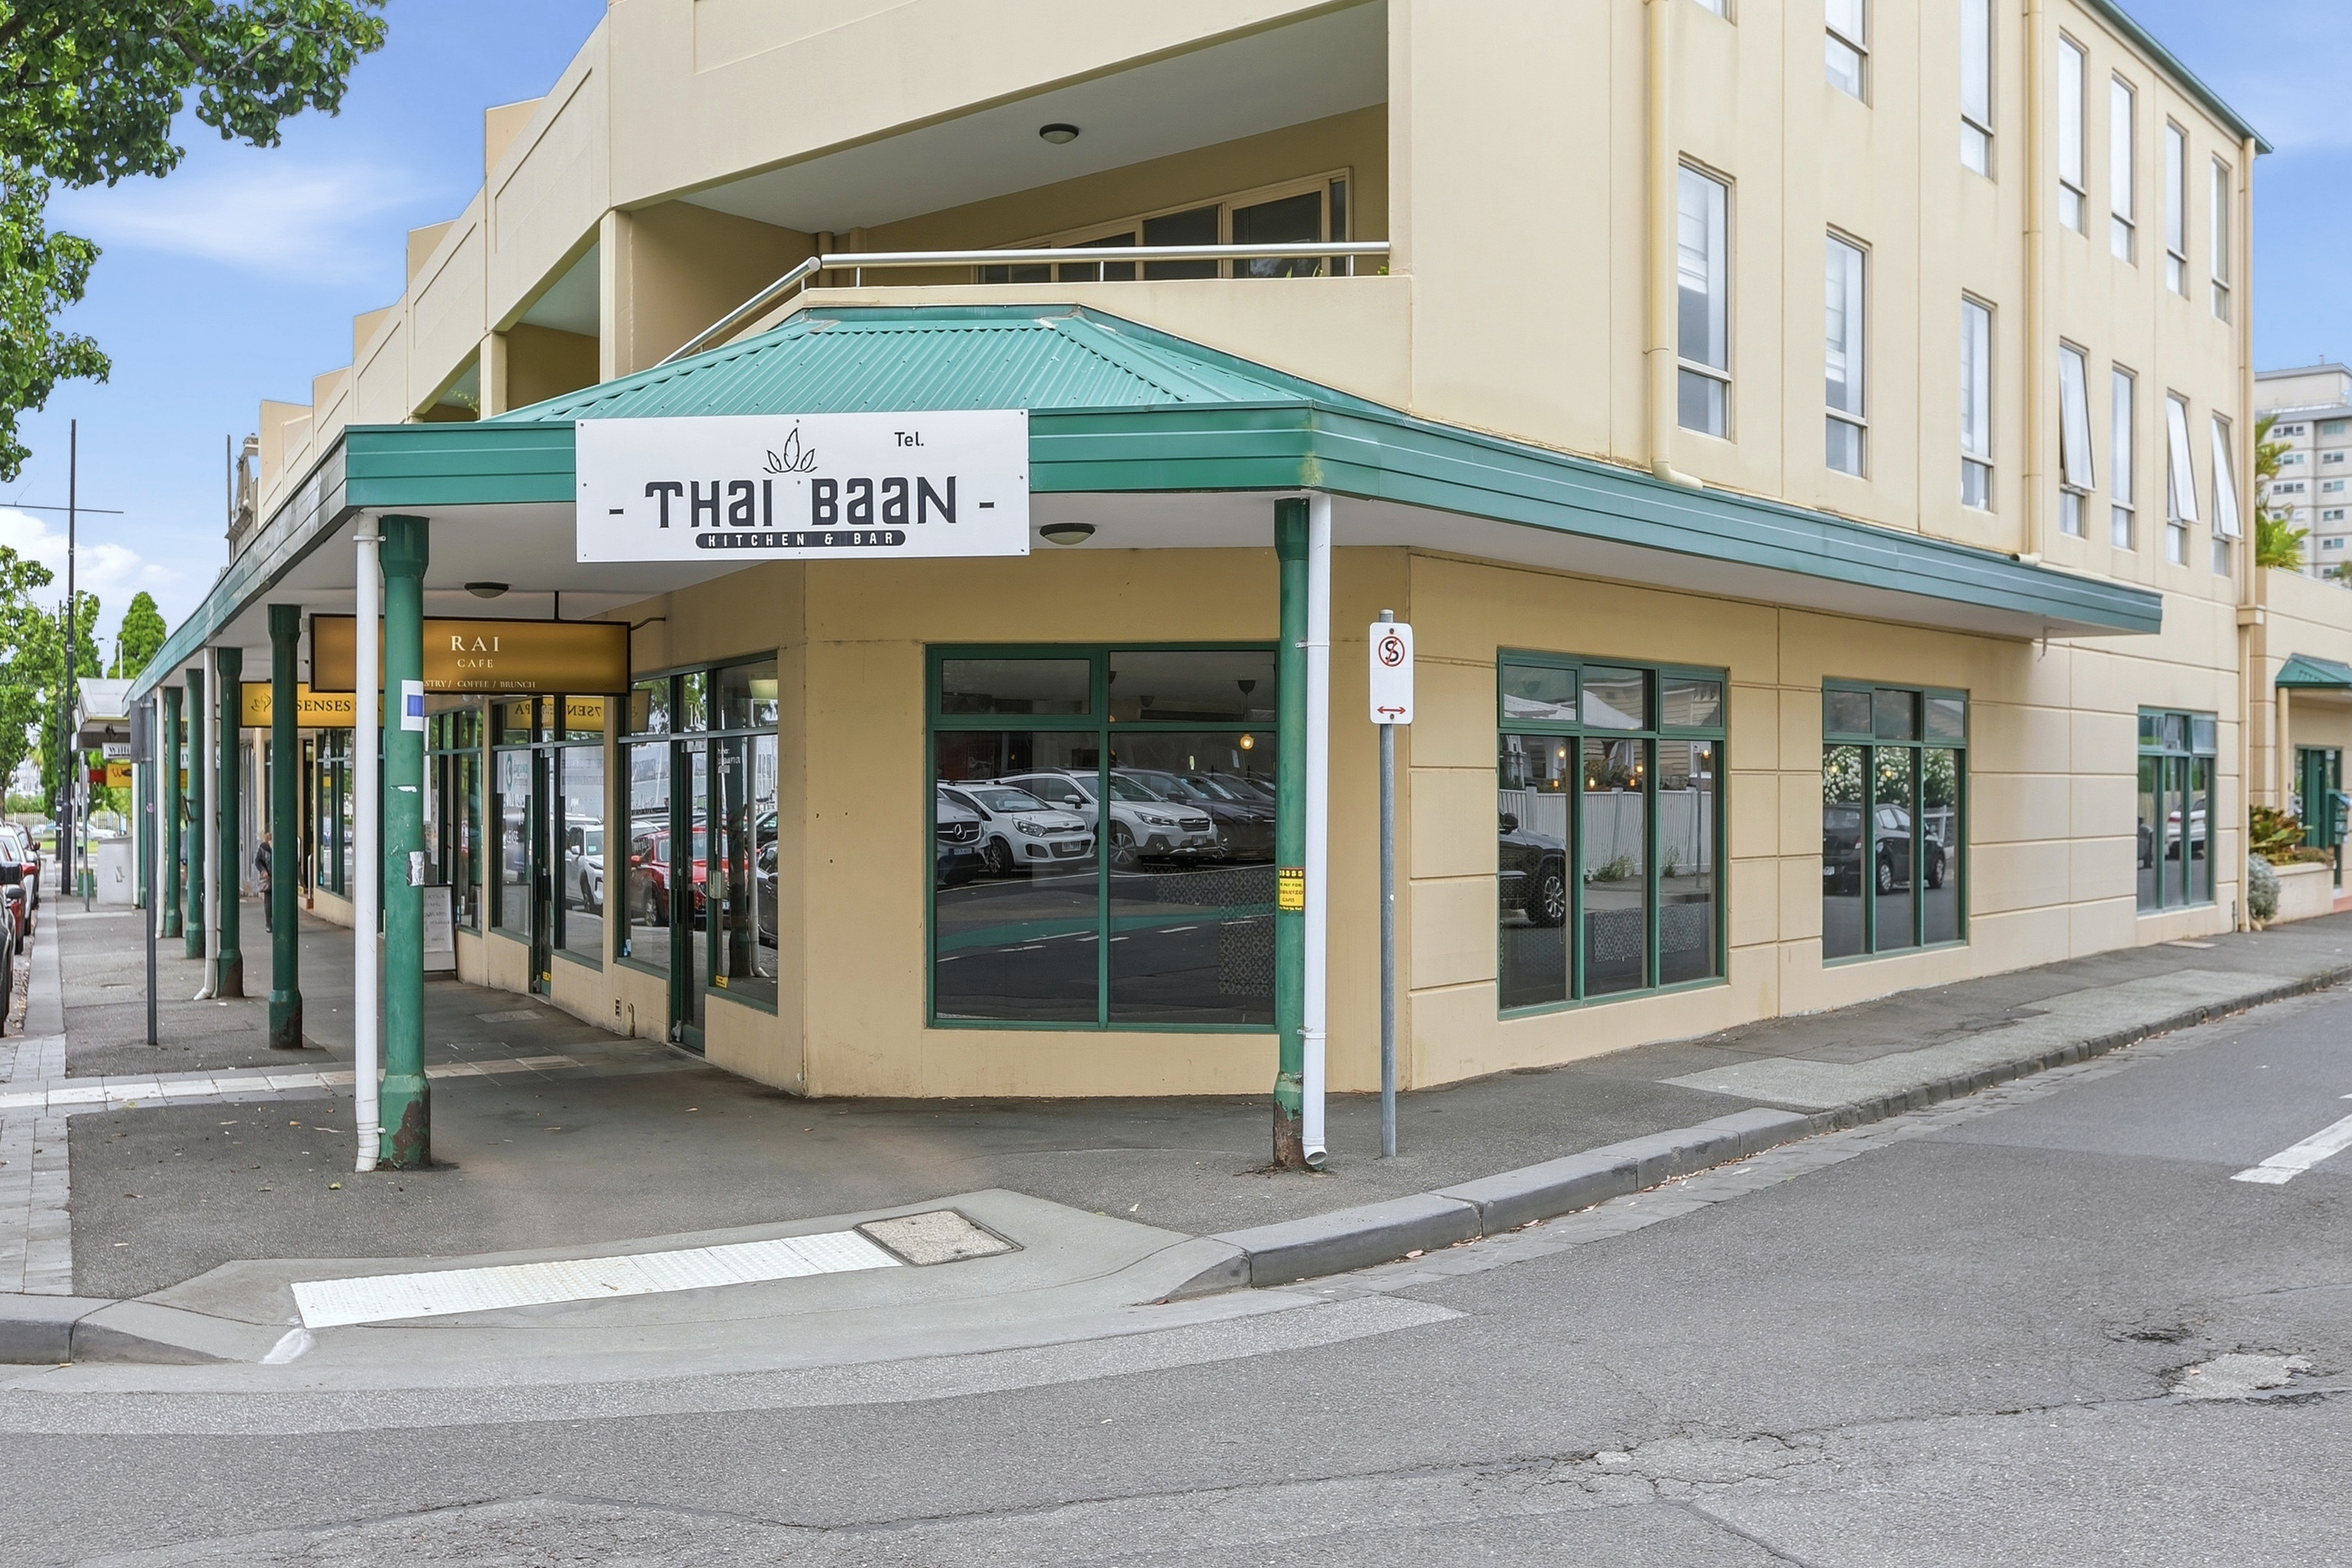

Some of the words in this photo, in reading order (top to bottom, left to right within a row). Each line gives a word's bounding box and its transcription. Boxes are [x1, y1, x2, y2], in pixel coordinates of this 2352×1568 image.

[894, 432, 925, 447] Tel.
[708, 533, 806, 547] KITCHEN
[824, 533, 834, 545] &
[854, 531, 894, 545] BAR
[450, 636, 499, 651] RAI
[457, 659, 493, 668] CAFE
[297, 700, 350, 711] SENSES
[690, 702, 700, 727] 18
